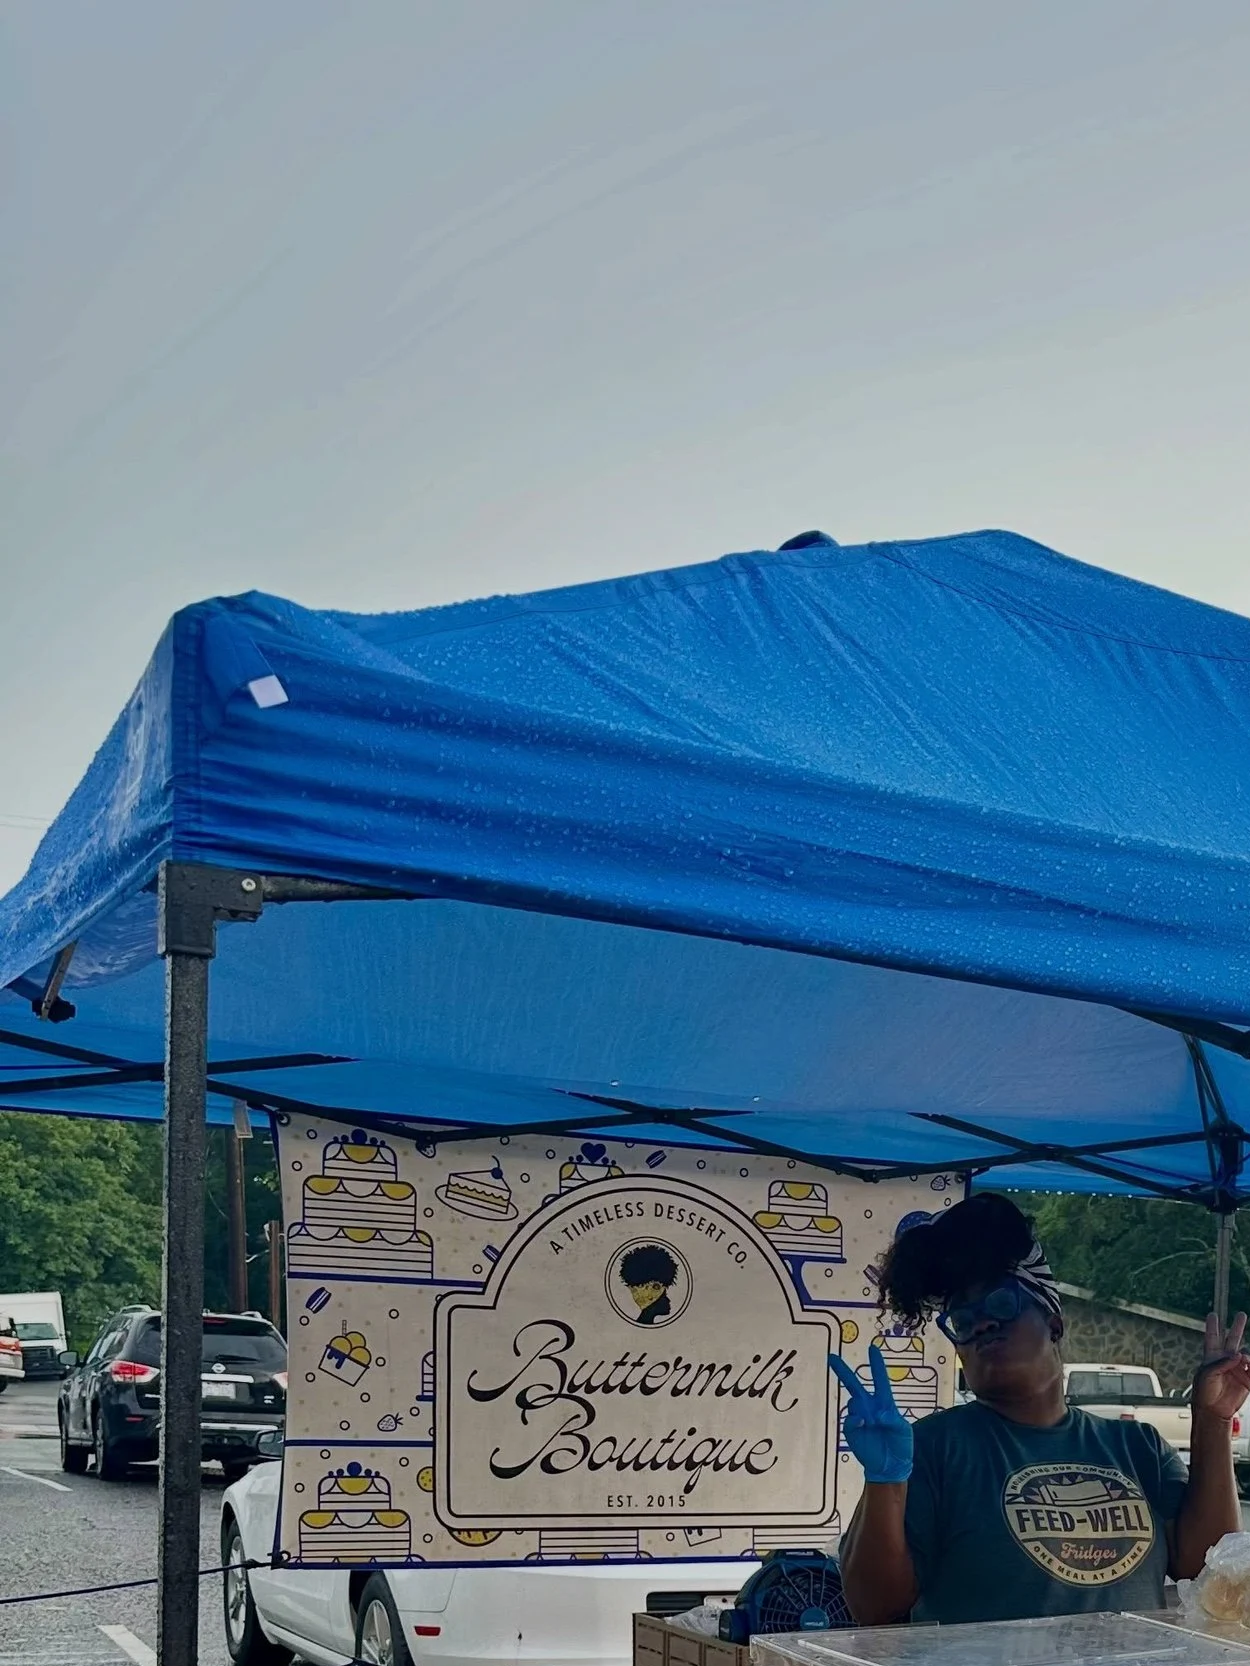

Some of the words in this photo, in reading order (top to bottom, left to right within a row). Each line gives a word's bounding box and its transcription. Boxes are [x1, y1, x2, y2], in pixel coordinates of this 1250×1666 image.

[550, 1240, 564, 1255] A
[561, 1201, 645, 1242] TIMELESS
[654, 1202, 727, 1243] DESSERT
[727, 1242, 748, 1269] CO.
[467, 1319, 799, 1412] Buttermilk
[489, 1392, 779, 1494] Boutique
[607, 1495, 639, 1508] EST.
[647, 1494, 686, 1508] 2015
[1016, 1505, 1150, 1533] FEED-WELL
[1033, 1546, 1052, 1565] ONE
[1057, 1566, 1086, 1581] MEAL
[1092, 1572, 1105, 1580] AT
[1121, 1546, 1143, 1568] TIME
[1060, 1542, 1118, 1567] Fridges
